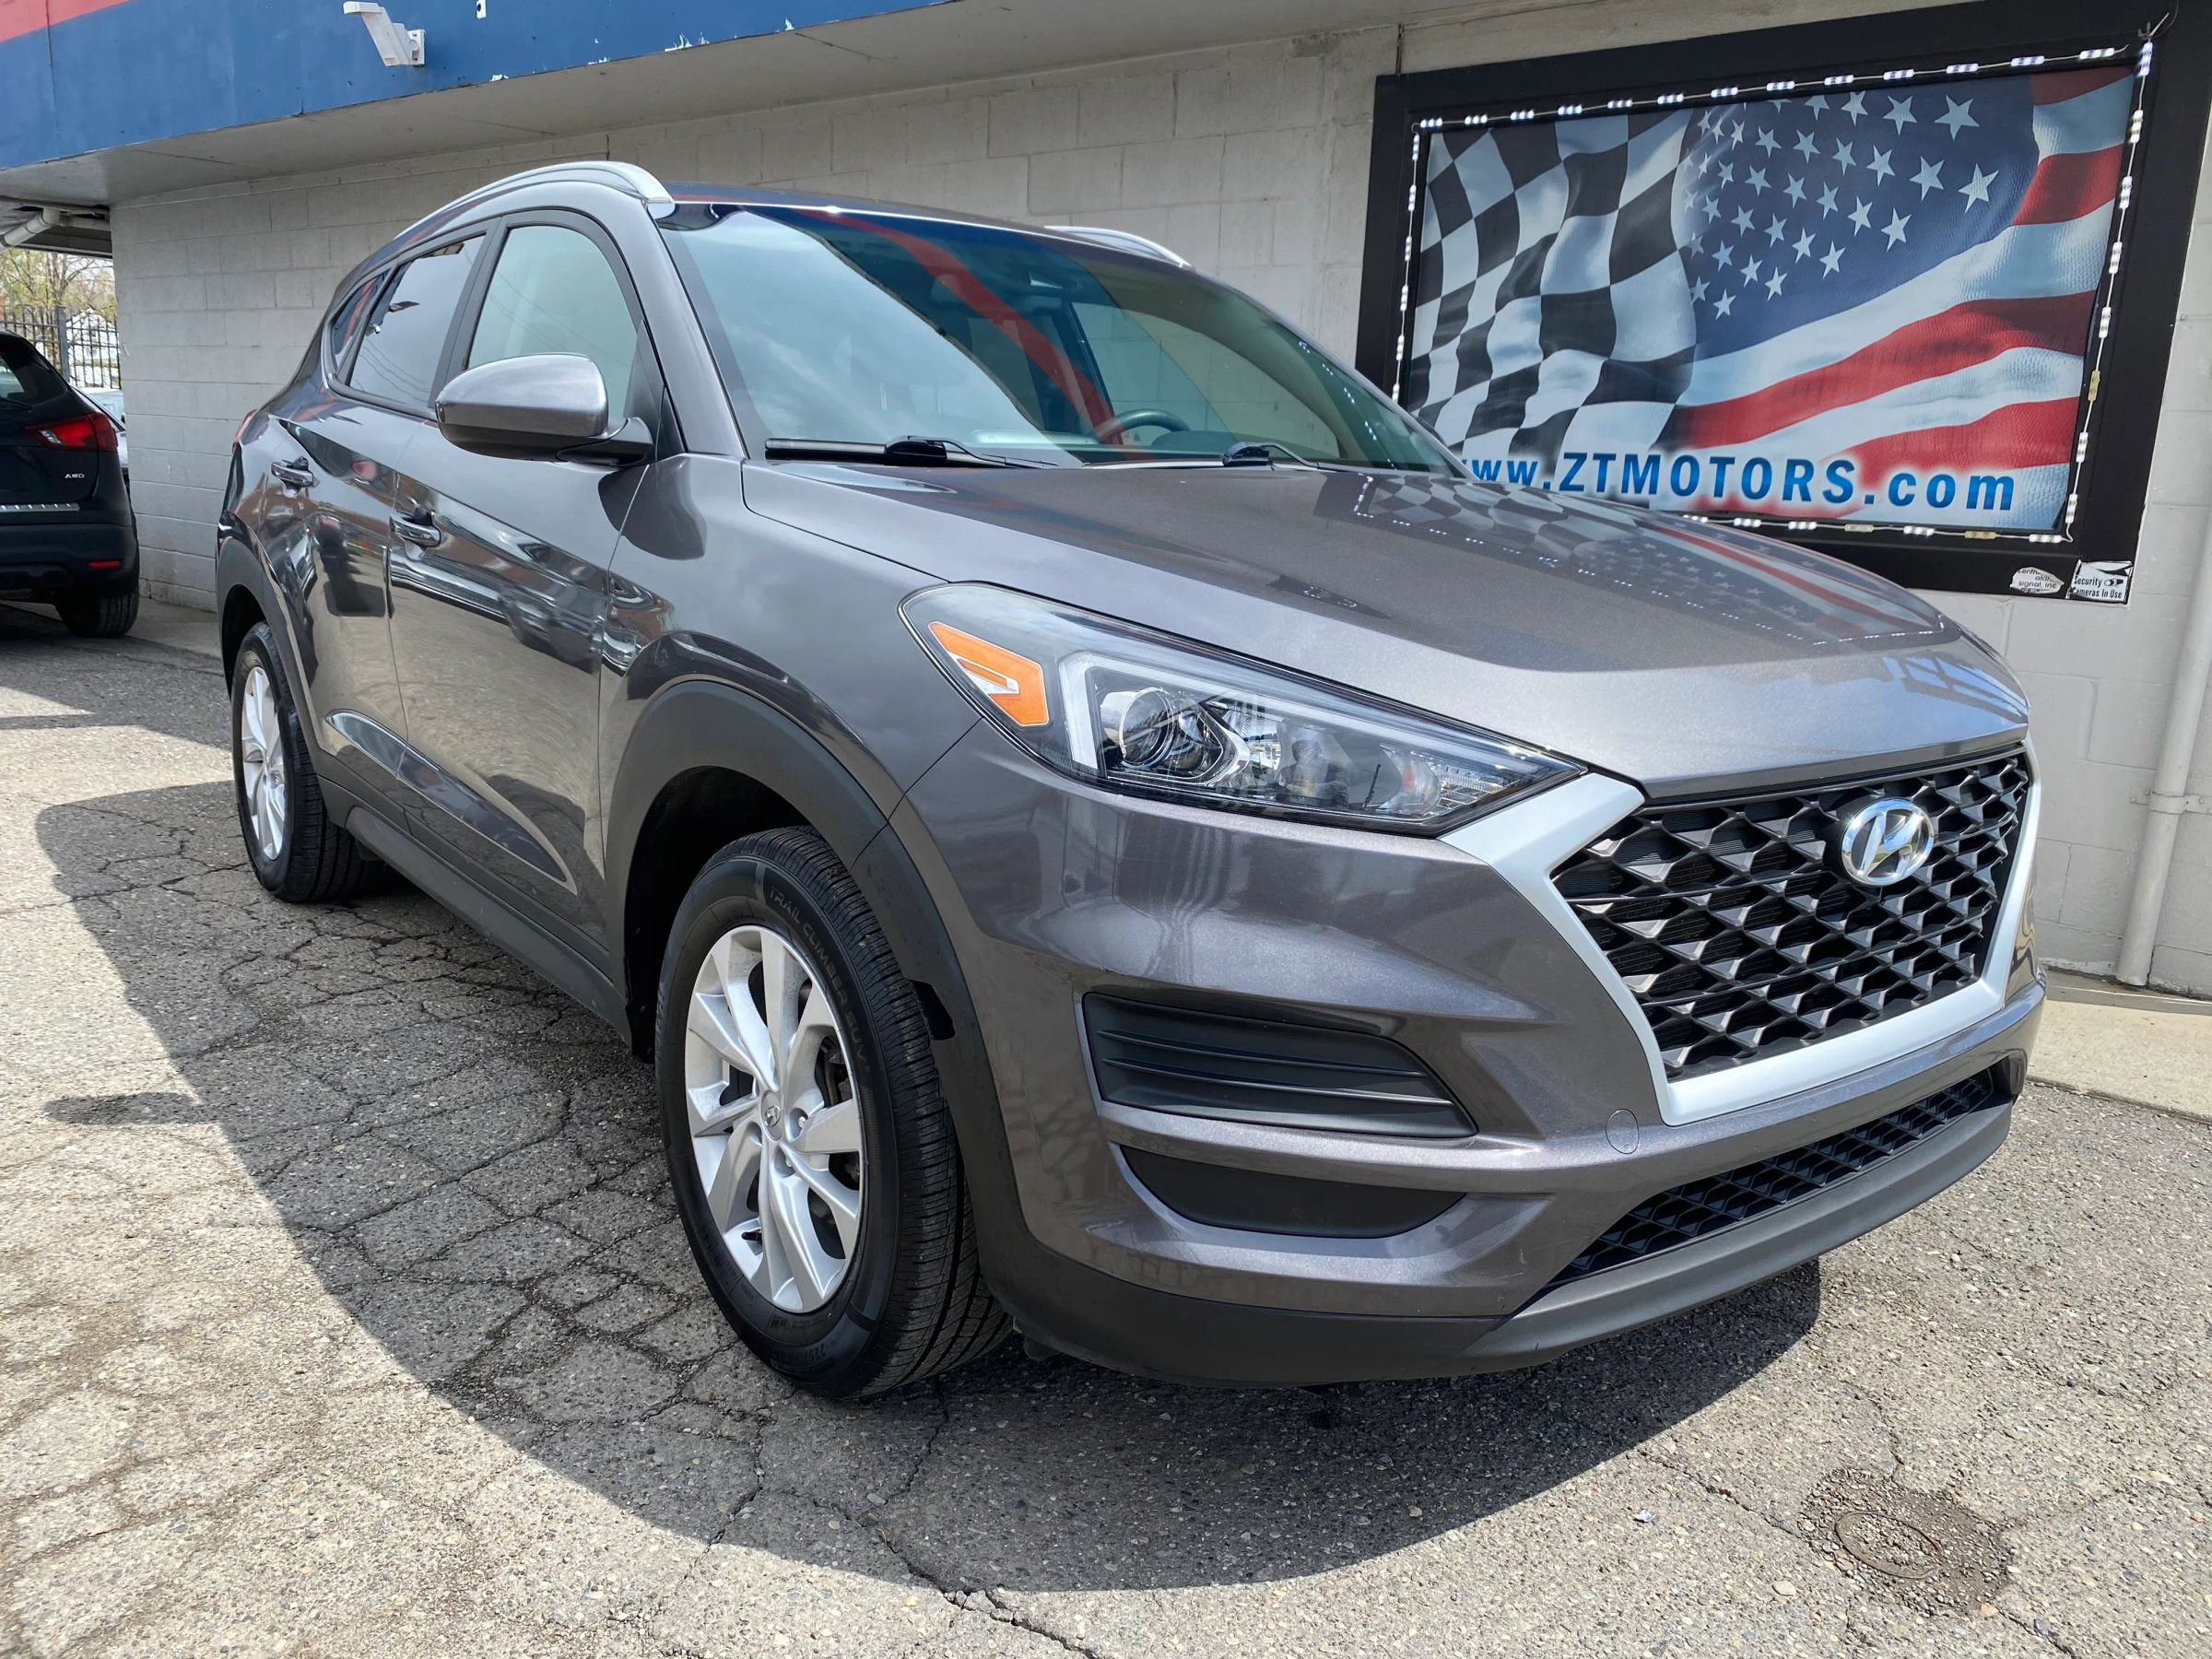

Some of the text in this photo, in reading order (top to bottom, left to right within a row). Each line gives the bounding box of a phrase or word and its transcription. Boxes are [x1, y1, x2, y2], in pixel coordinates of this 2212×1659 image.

[1463, 452, 2015, 511] ww.ZTMOTORS.com
[2074, 575, 2102, 588] Security
[2101, 588, 2108, 597] In
[2110, 589, 2123, 599] Use
